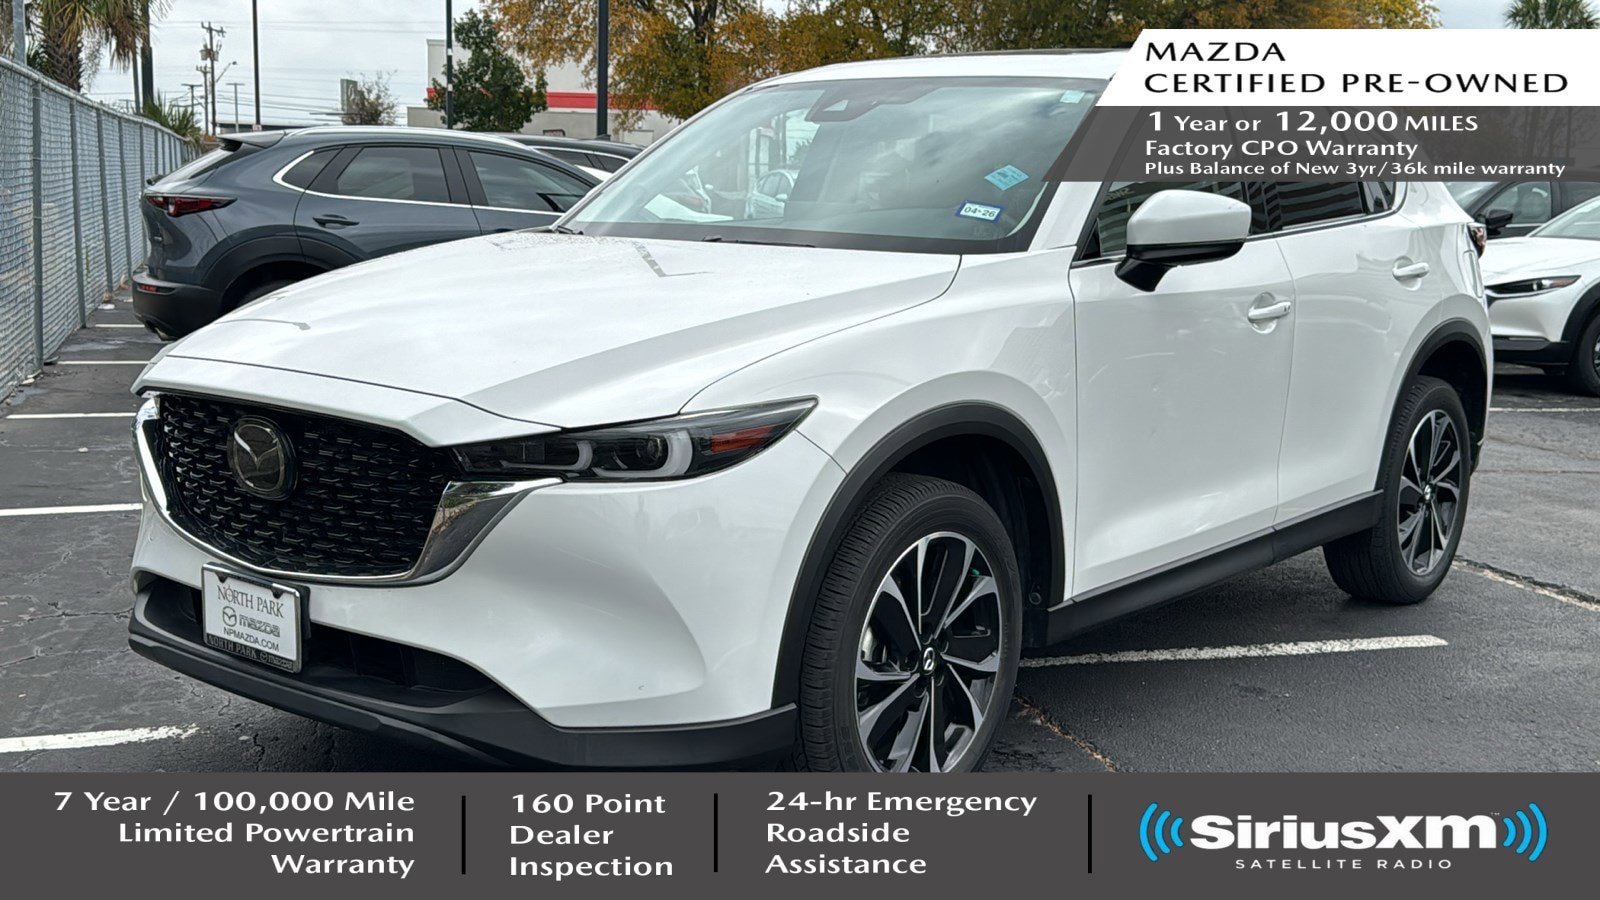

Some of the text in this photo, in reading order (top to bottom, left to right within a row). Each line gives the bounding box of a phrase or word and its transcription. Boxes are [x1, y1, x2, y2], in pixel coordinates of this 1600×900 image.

[217, 584, 284, 619] NORTH PARK
[208, 635, 234, 653] NORTH
[236, 643, 258, 659] PARK
[223, 626, 280, 652] NPMAZDA.COM
